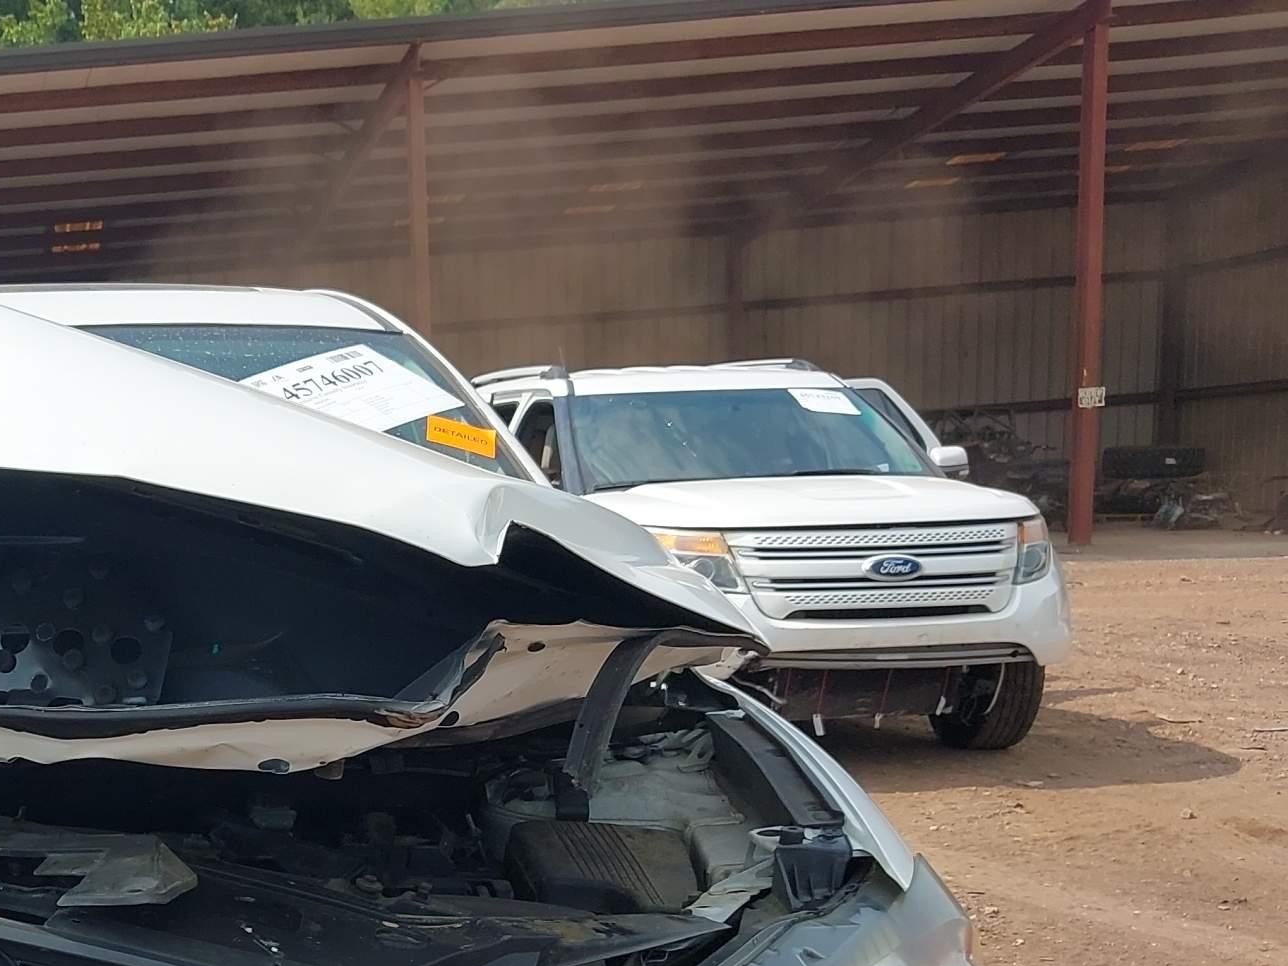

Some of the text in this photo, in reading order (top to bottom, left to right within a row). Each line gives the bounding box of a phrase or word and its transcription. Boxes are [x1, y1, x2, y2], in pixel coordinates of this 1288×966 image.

[282, 360, 384, 400] 45746007
[433, 426, 488, 445] DETAILED
[880, 560, 912, 574] Ford
